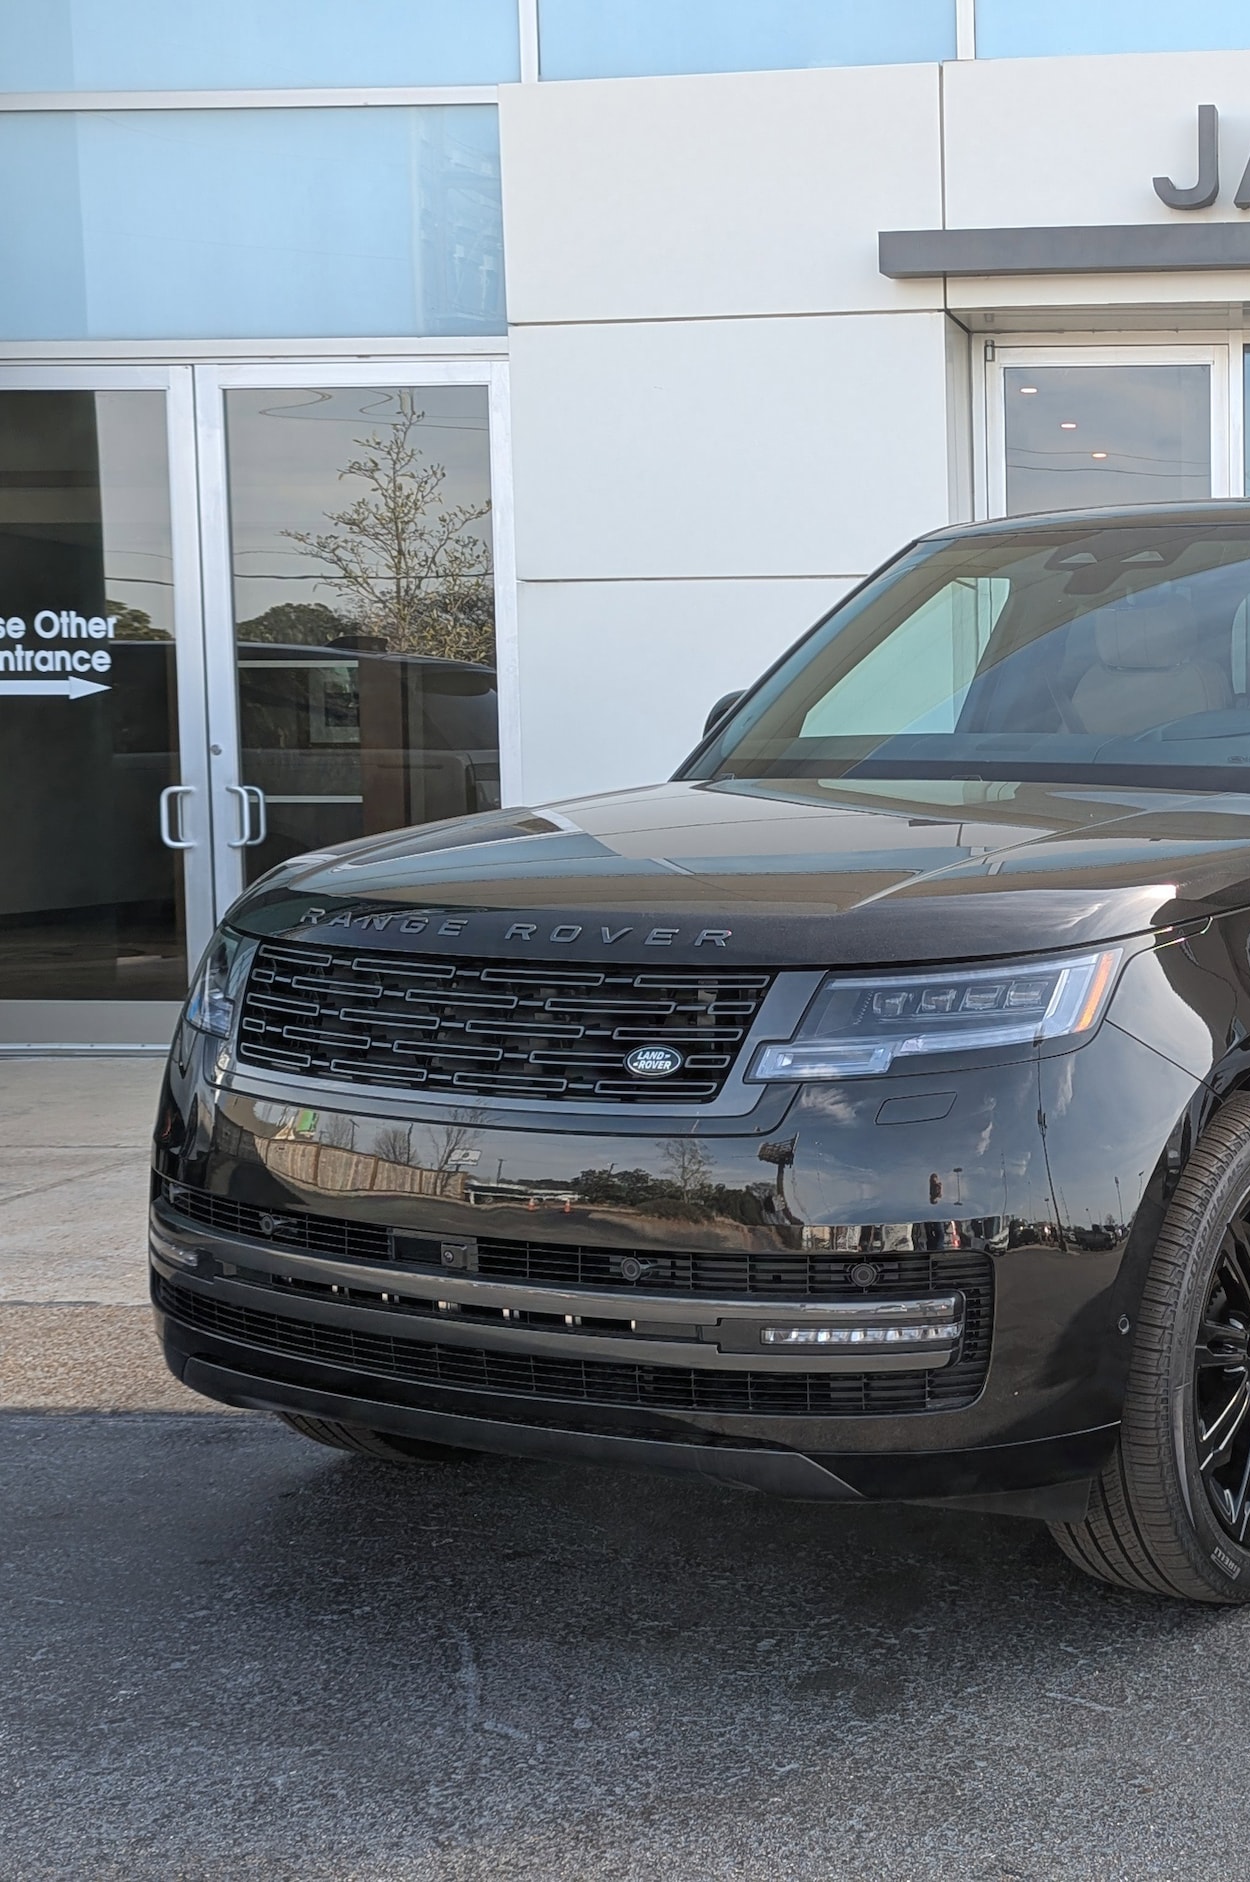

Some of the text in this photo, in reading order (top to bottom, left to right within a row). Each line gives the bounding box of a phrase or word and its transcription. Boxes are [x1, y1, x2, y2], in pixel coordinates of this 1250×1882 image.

[34, 610, 117, 639] Other
[300, 907, 733, 948] RANGE ROVER
[637, 1051, 665, 1060] LAND
[637, 1060, 672, 1070] ROVER
[1210, 1546, 1241, 1580] PIRELLI
